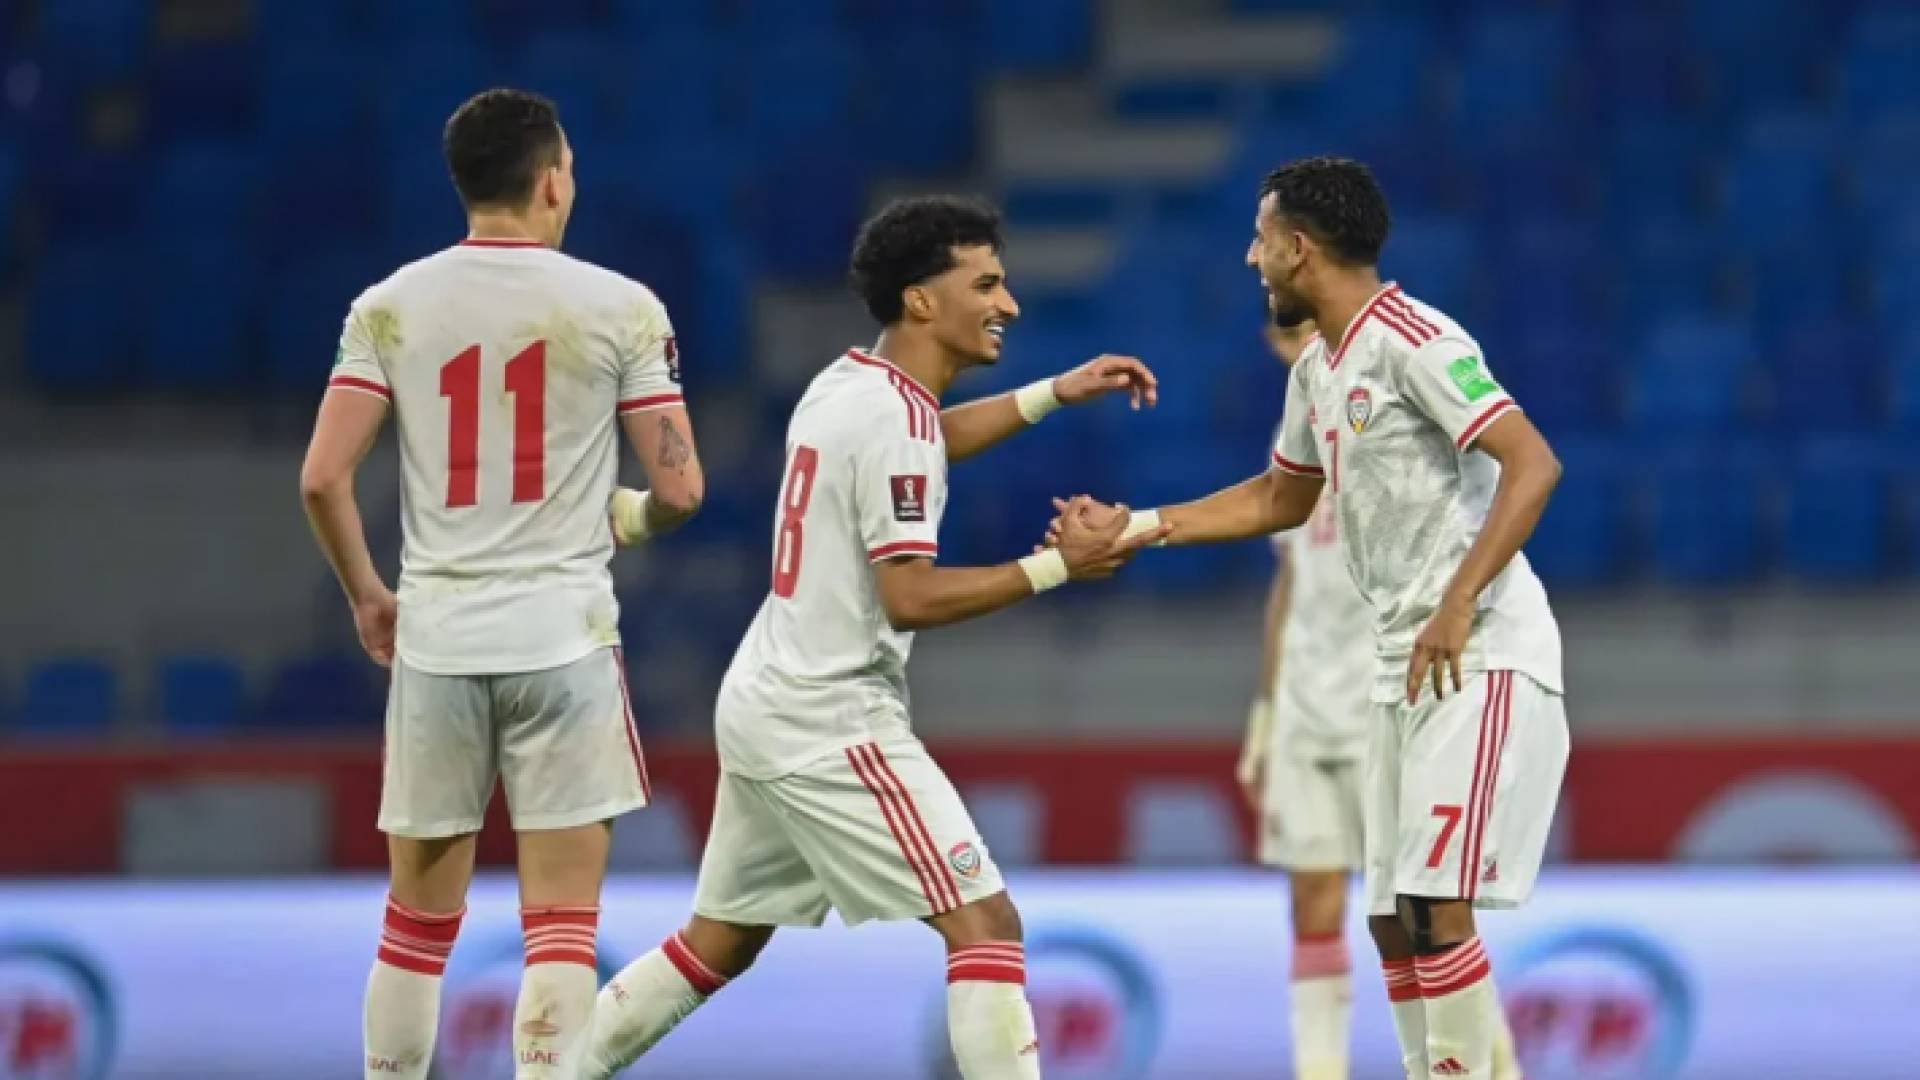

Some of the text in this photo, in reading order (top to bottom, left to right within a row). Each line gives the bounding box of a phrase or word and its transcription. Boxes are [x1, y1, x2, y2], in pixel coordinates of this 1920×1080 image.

[440, 339, 546, 508] 11
[1425, 804, 1463, 868] 7
[520, 1049, 561, 1066] UAE
